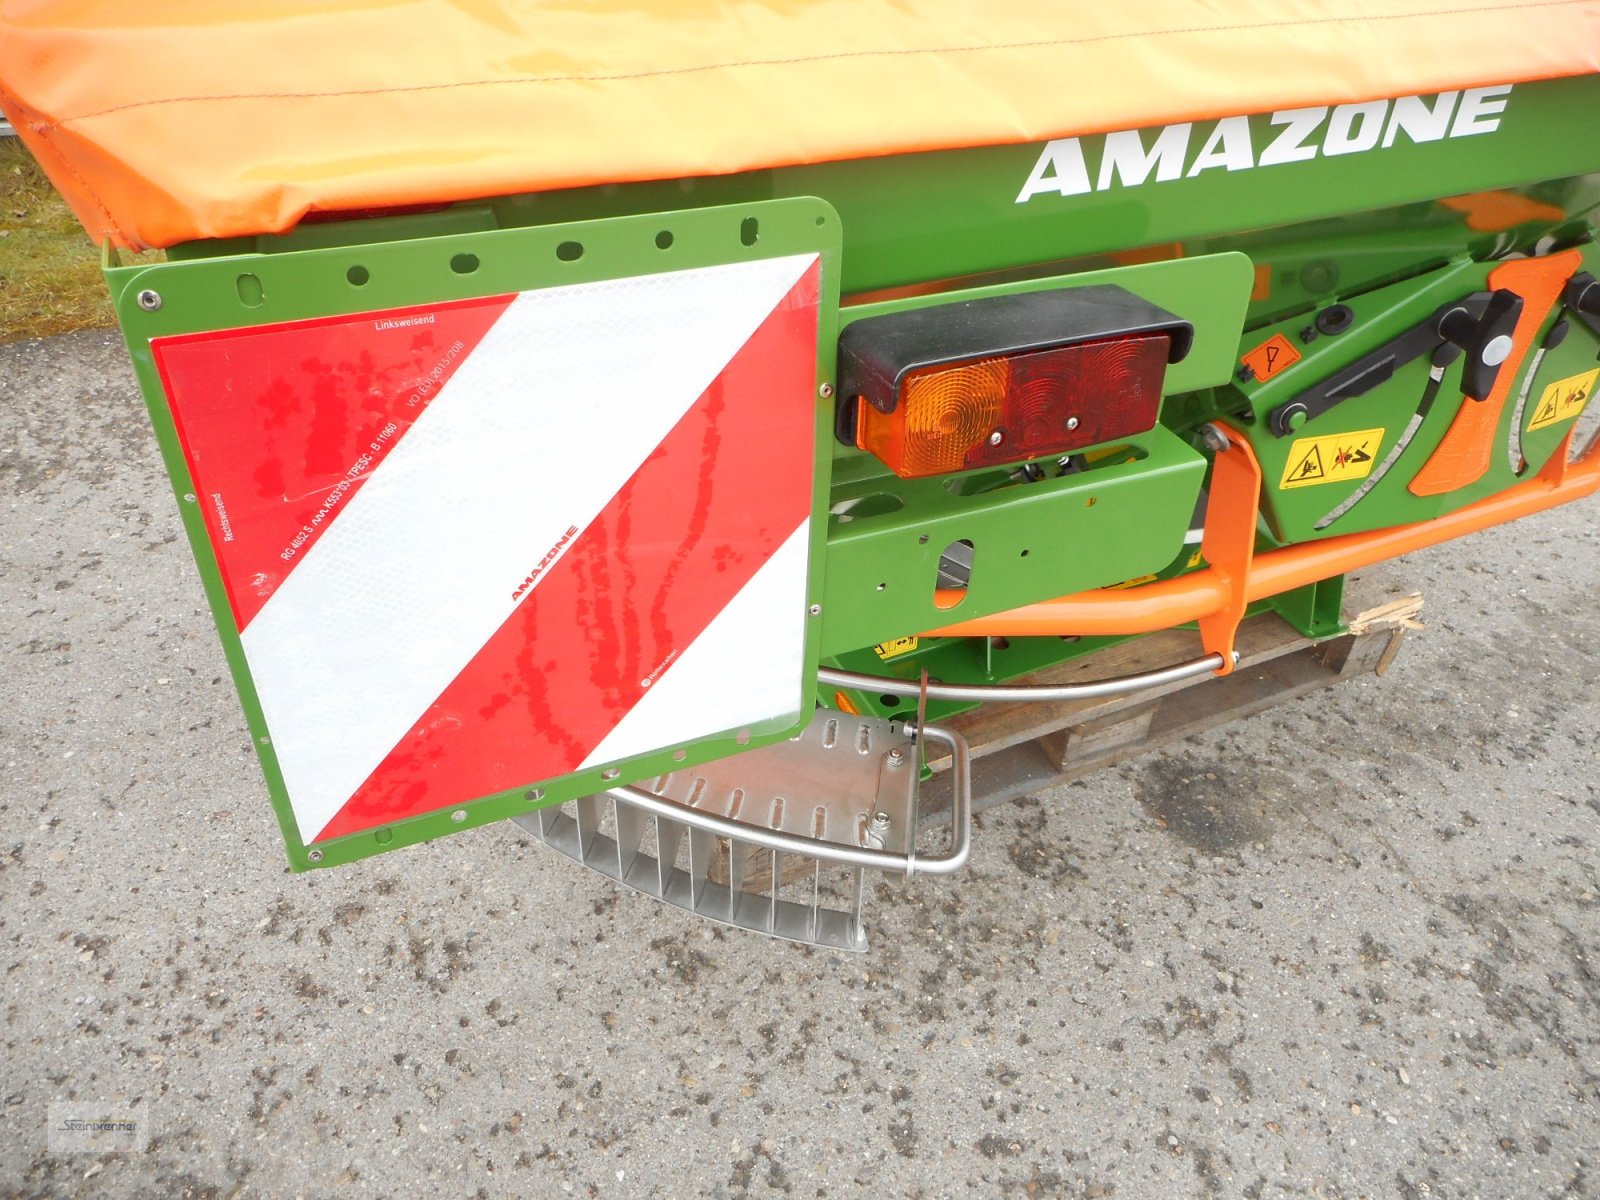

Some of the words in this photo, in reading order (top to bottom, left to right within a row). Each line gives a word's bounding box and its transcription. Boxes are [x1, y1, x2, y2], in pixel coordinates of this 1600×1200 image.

[1015, 84, 1514, 204] AMAZONE
[375, 314, 435, 331] Linksweisend
[430, 340, 464, 379] 2015/208
[211, 493, 234, 542] Rechtsweisend
[280, 547, 296, 561] RG
[291, 531, 309, 549] 4052
[303, 525, 314, 533] S
[347, 453, 373, 478] TPESC
[370, 442, 381, 451] B
[377, 422, 398, 444] 11060
[512, 525, 579, 601] AMAZONE
